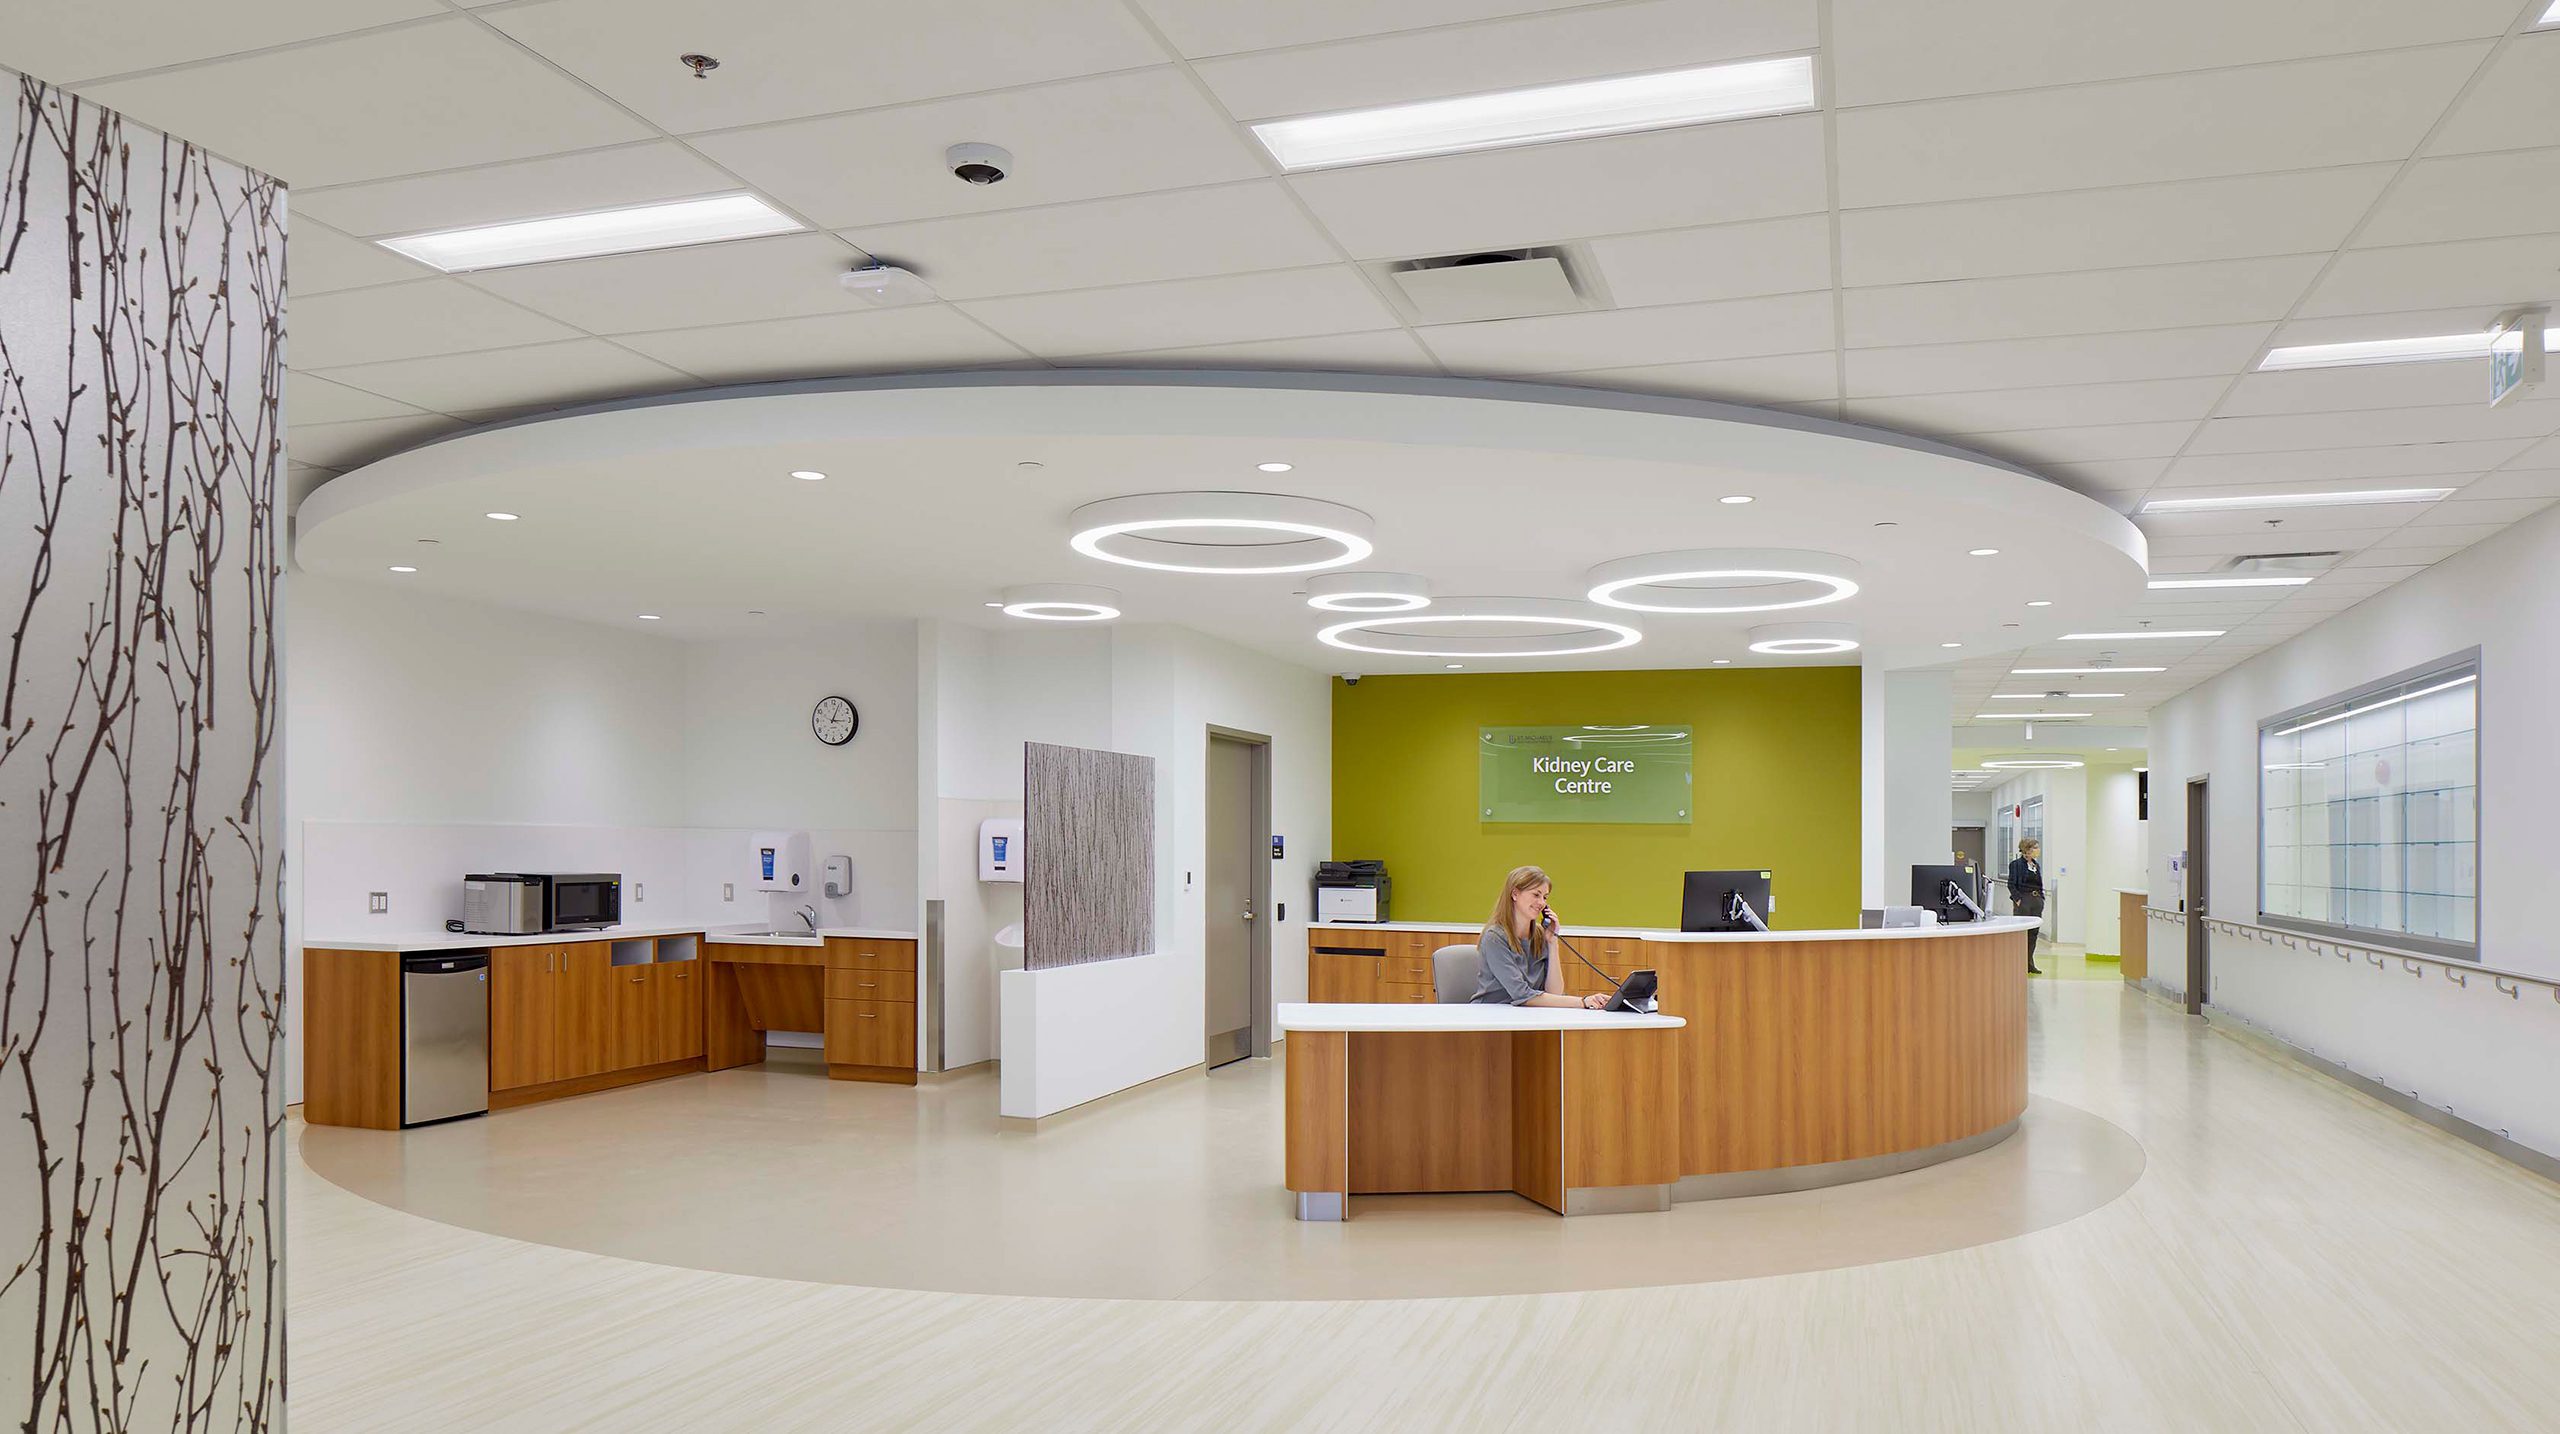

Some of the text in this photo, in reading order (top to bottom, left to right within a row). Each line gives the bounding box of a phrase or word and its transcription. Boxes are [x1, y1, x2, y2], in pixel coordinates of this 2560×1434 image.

[1533, 756, 1635, 778] Kidney Care
[1554, 778, 1612, 794] Centre
